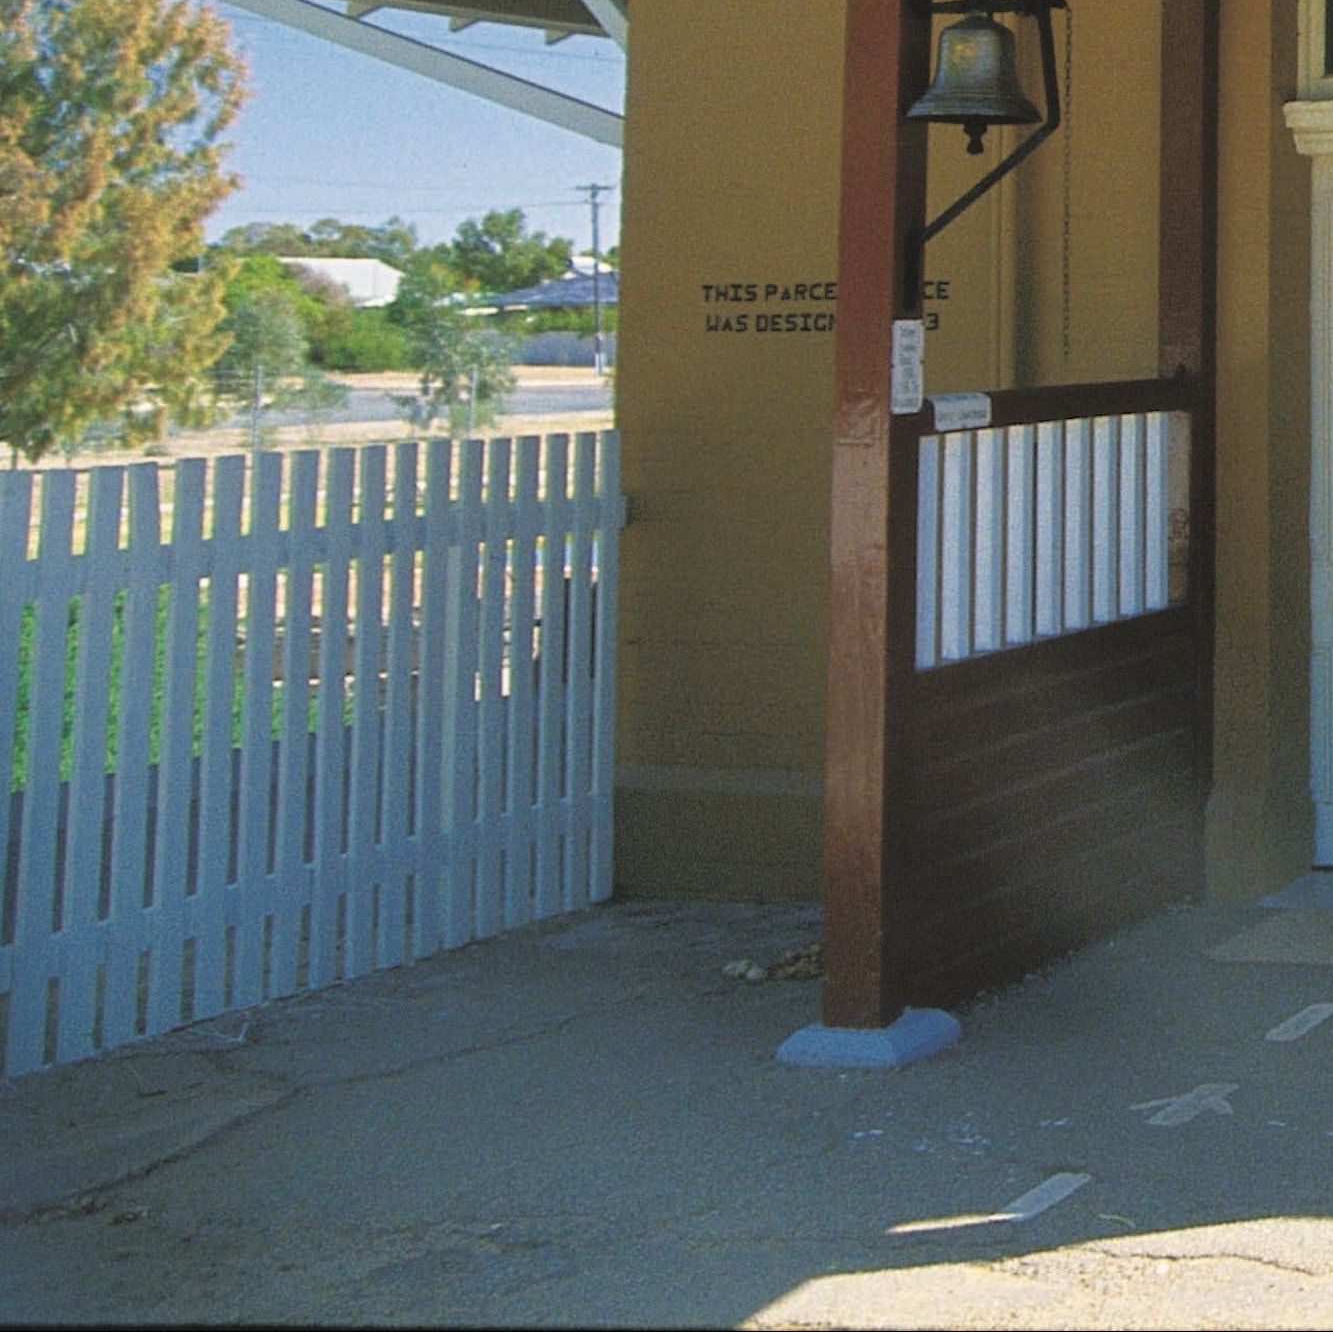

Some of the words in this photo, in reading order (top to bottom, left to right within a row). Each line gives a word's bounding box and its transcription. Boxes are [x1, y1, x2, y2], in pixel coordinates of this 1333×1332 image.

[702, 284, 758, 302] THIS
[765, 282, 837, 301] PARCE
[706, 314, 749, 332] WAS
